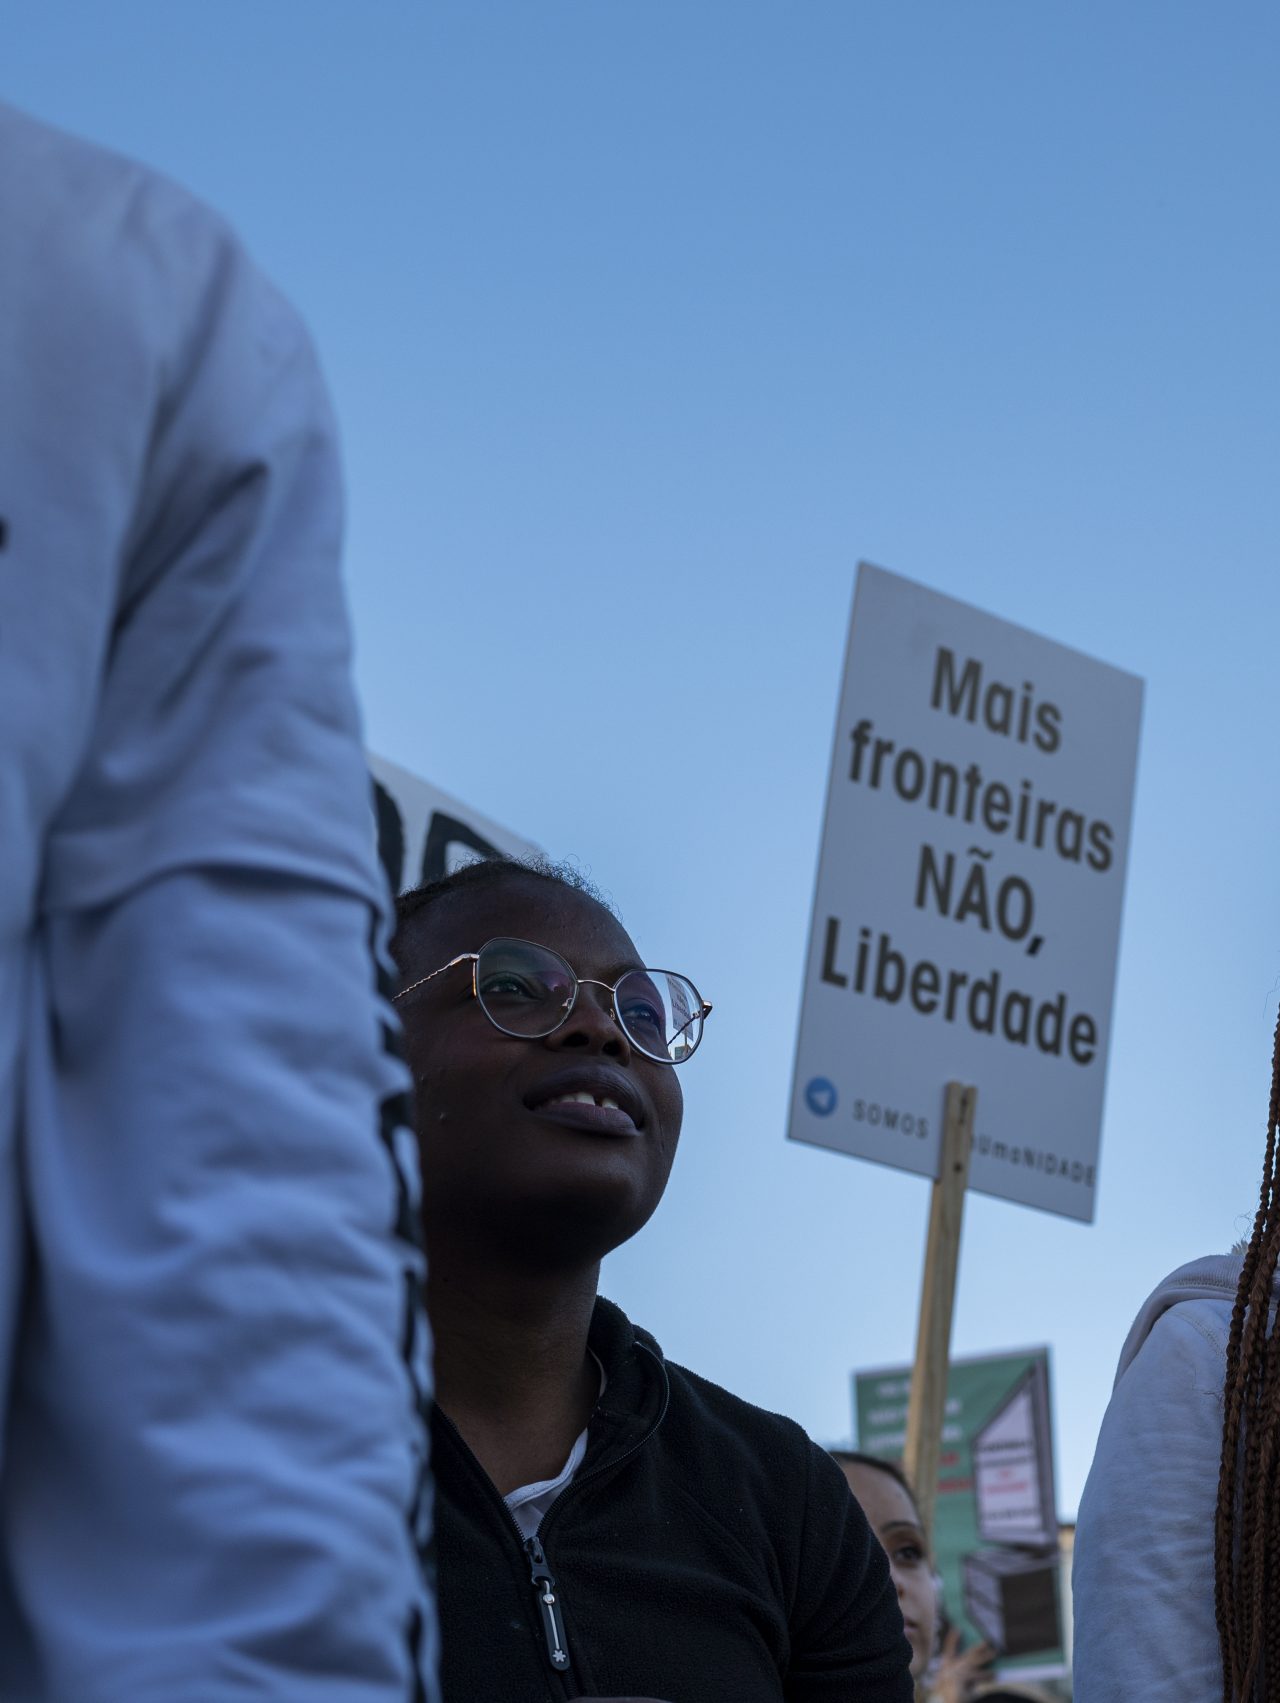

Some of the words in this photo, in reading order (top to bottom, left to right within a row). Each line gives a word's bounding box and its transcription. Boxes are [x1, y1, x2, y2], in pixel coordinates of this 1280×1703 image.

[930, 645, 1062, 755] Mais
[849, 718, 1114, 874] fronteiras
[914, 844, 1044, 957] NÃO,
[820, 915, 1097, 1066] Liberdade
[853, 1100, 929, 1139] SOMOS
